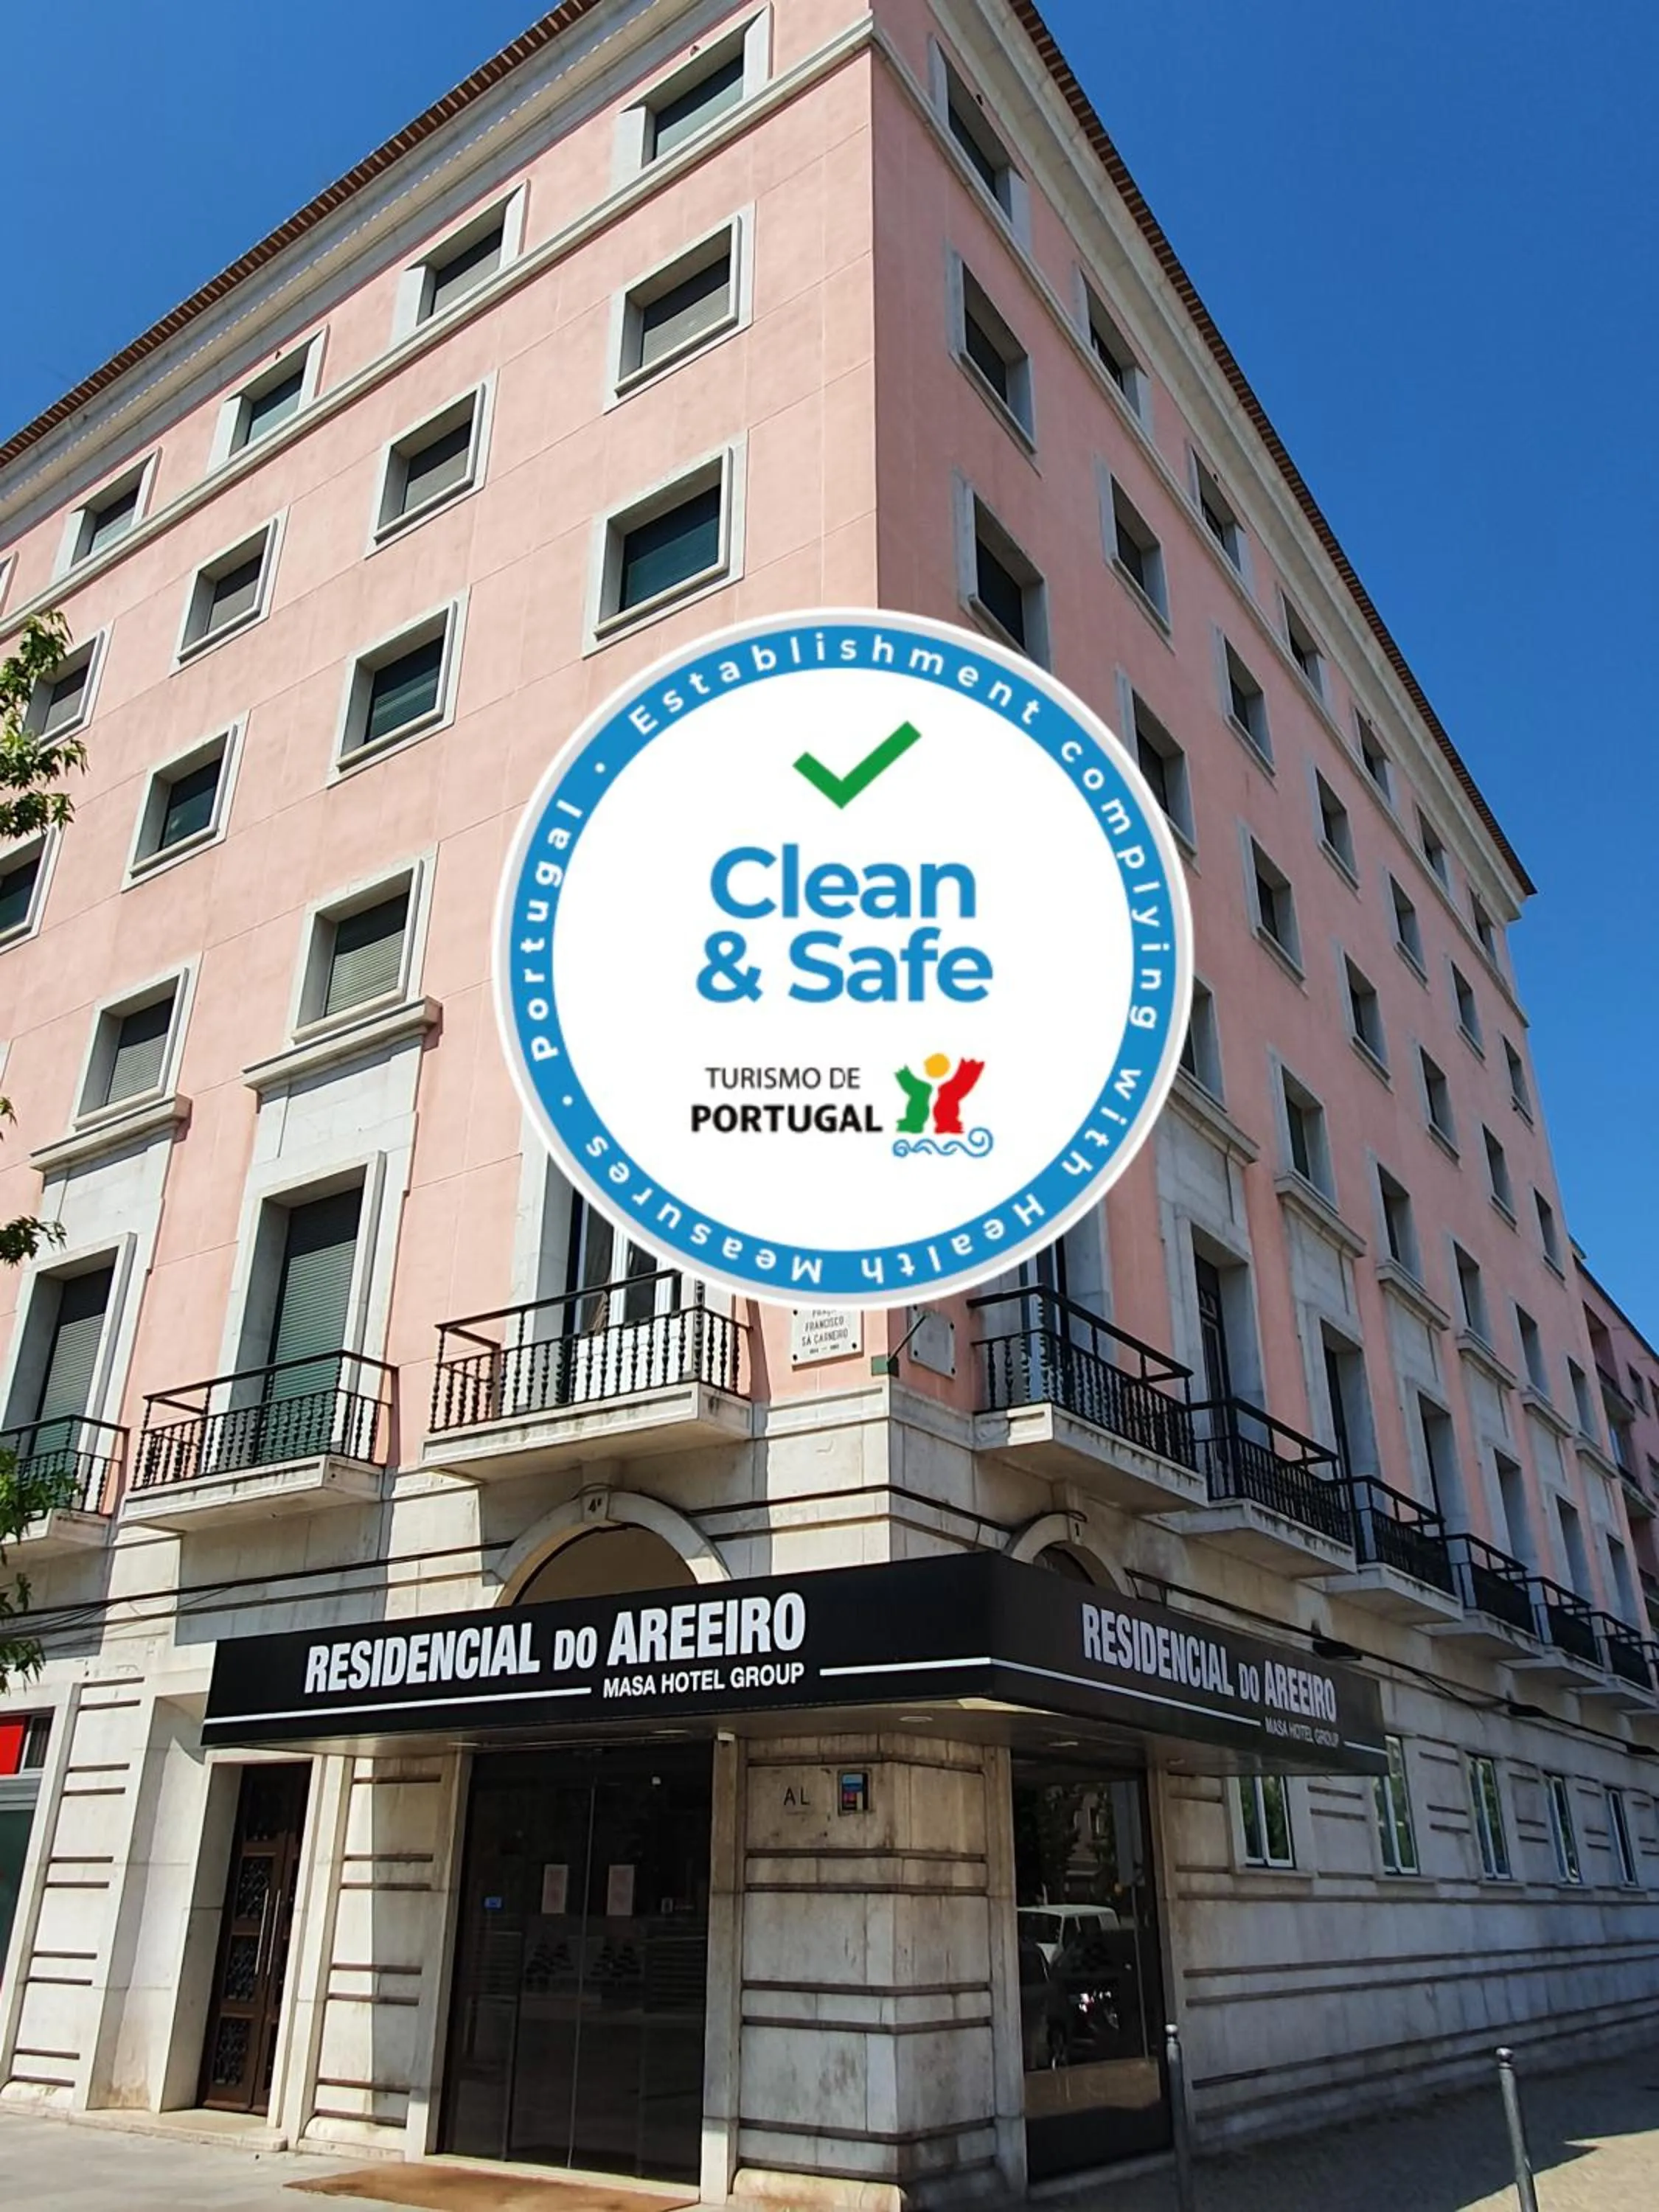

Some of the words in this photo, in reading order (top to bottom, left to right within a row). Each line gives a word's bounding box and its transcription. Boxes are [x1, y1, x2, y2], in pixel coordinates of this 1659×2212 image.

[304, 1622, 540, 1694] RESIDENCIAL
[553, 1627, 597, 1671] DO
[607, 1592, 806, 1666] AREEIRO
[603, 1674, 656, 1698] MASA
[661, 1669, 726, 1694] HOTEL
[730, 1662, 804, 1688] GROUP
[1082, 1603, 1235, 1697] RESIDENCIAL
[1238, 1663, 1260, 1703] DO
[1265, 1660, 1337, 1723] AREEIRO
[1265, 1716, 1289, 1738] MASA
[783, 1787, 810, 1806] AL
